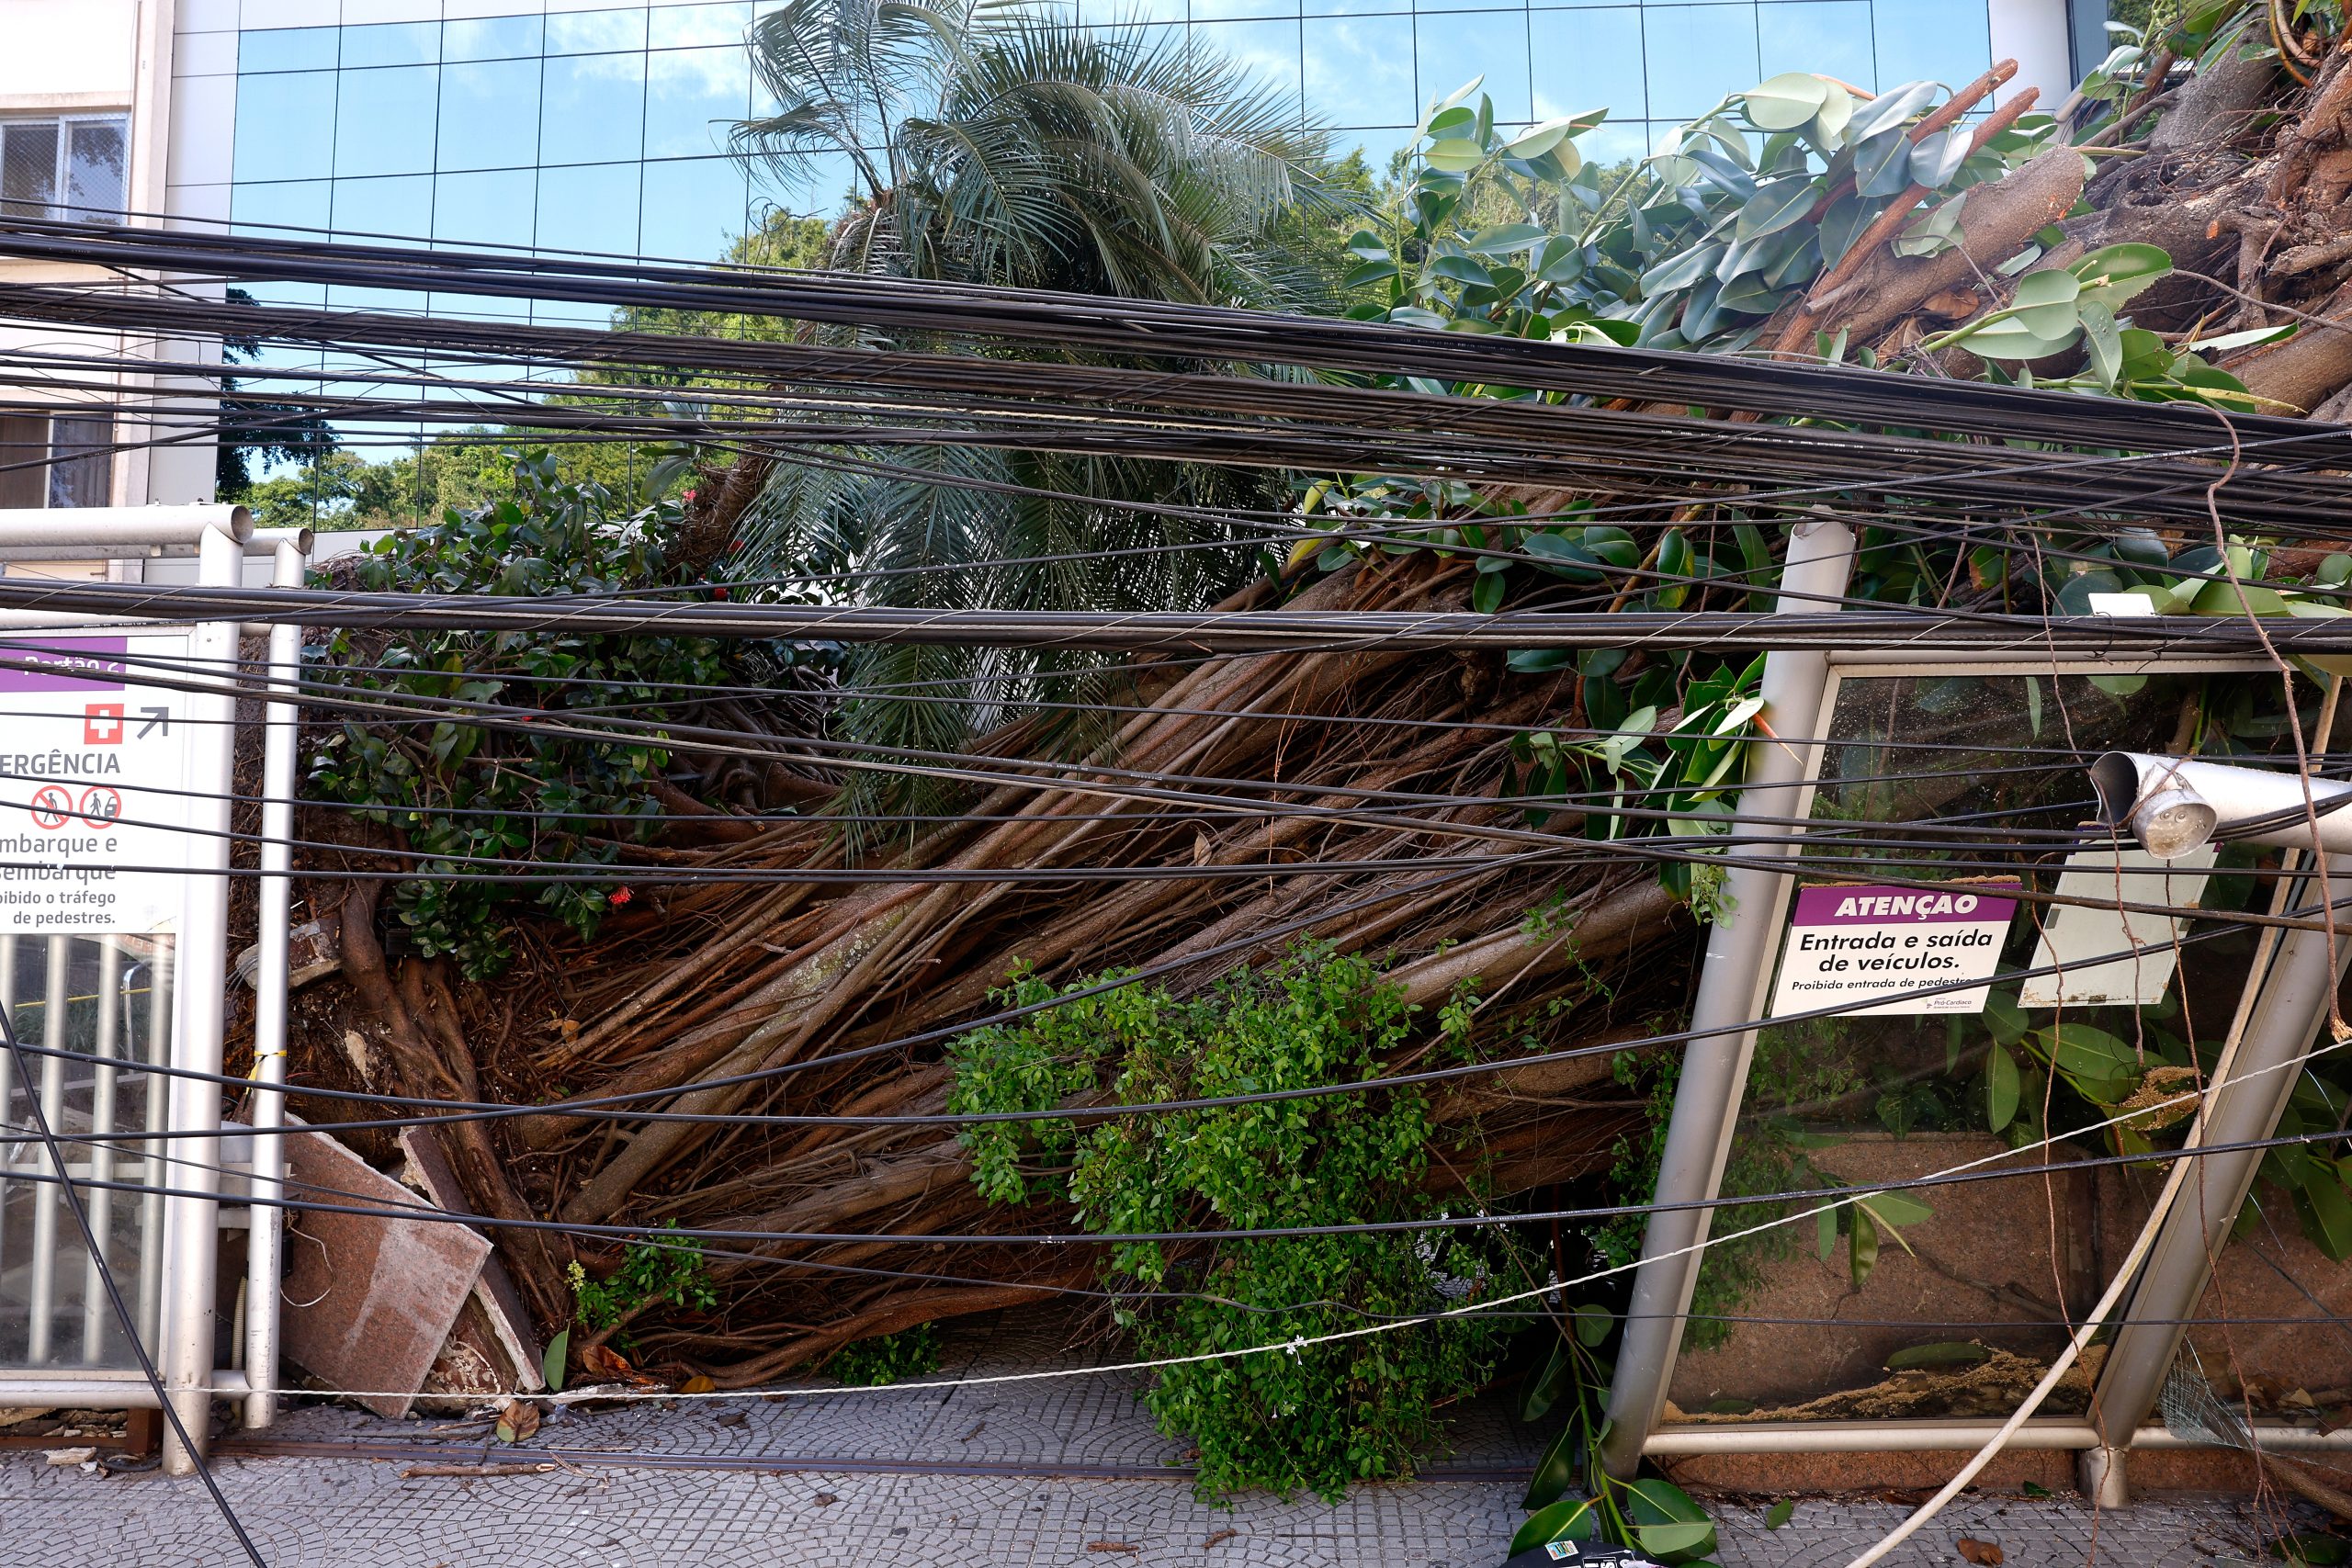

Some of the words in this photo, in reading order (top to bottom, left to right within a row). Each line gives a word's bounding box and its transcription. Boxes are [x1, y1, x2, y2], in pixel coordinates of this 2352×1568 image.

[0, 749, 120, 774] ERGÊNCIA
[106, 837, 118, 852] e
[0, 861, 117, 886] embarque
[46, 894, 55, 904] o
[60, 890, 116, 907] tráfego
[1834, 892, 1978, 920] ATENÇÃO
[13, 910, 31, 923] de
[36, 910, 116, 928] pedestres.
[1800, 931, 1895, 951] Entrada
[1905, 935, 1918, 948] e
[1928, 929, 1993, 948] saída
[1818, 954, 1849, 972] de
[1858, 952, 1960, 971] veículos.
[1792, 979, 1843, 990] Proibida
[1847, 978, 1895, 989] entrada
[1899, 978, 1915, 987] de
